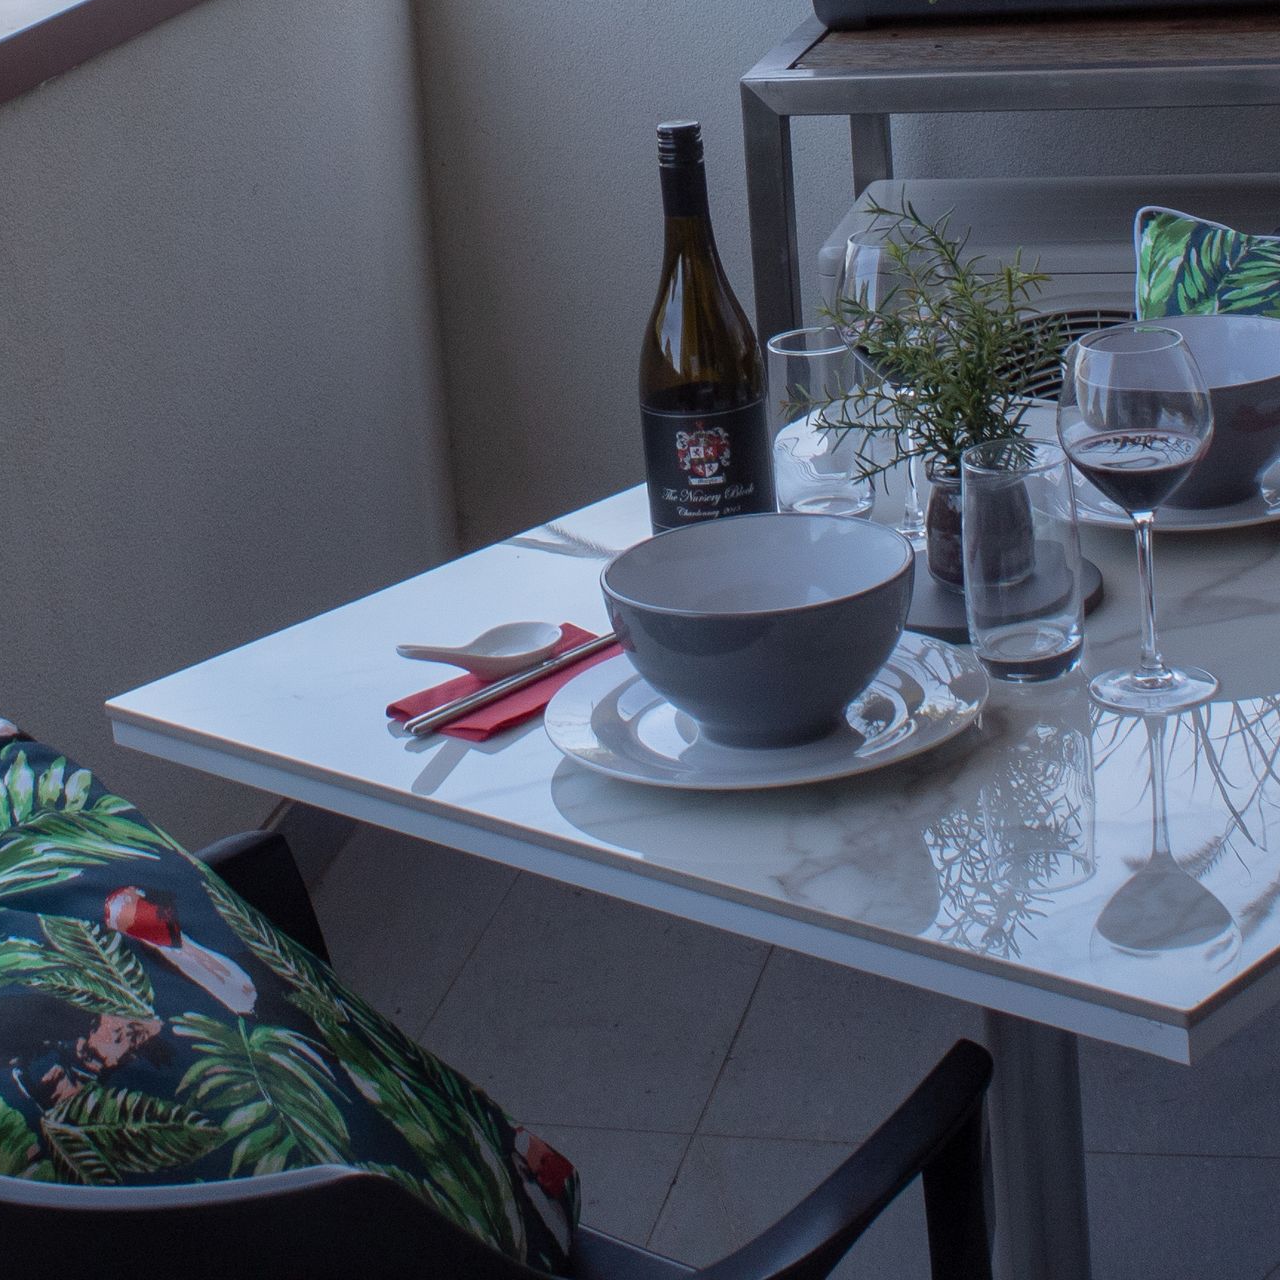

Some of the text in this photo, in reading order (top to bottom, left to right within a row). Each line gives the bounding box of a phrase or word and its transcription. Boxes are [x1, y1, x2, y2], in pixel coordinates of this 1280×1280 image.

[662, 482, 755, 506] The Nursery Block
[677, 506, 720, 518] Chardonnay
